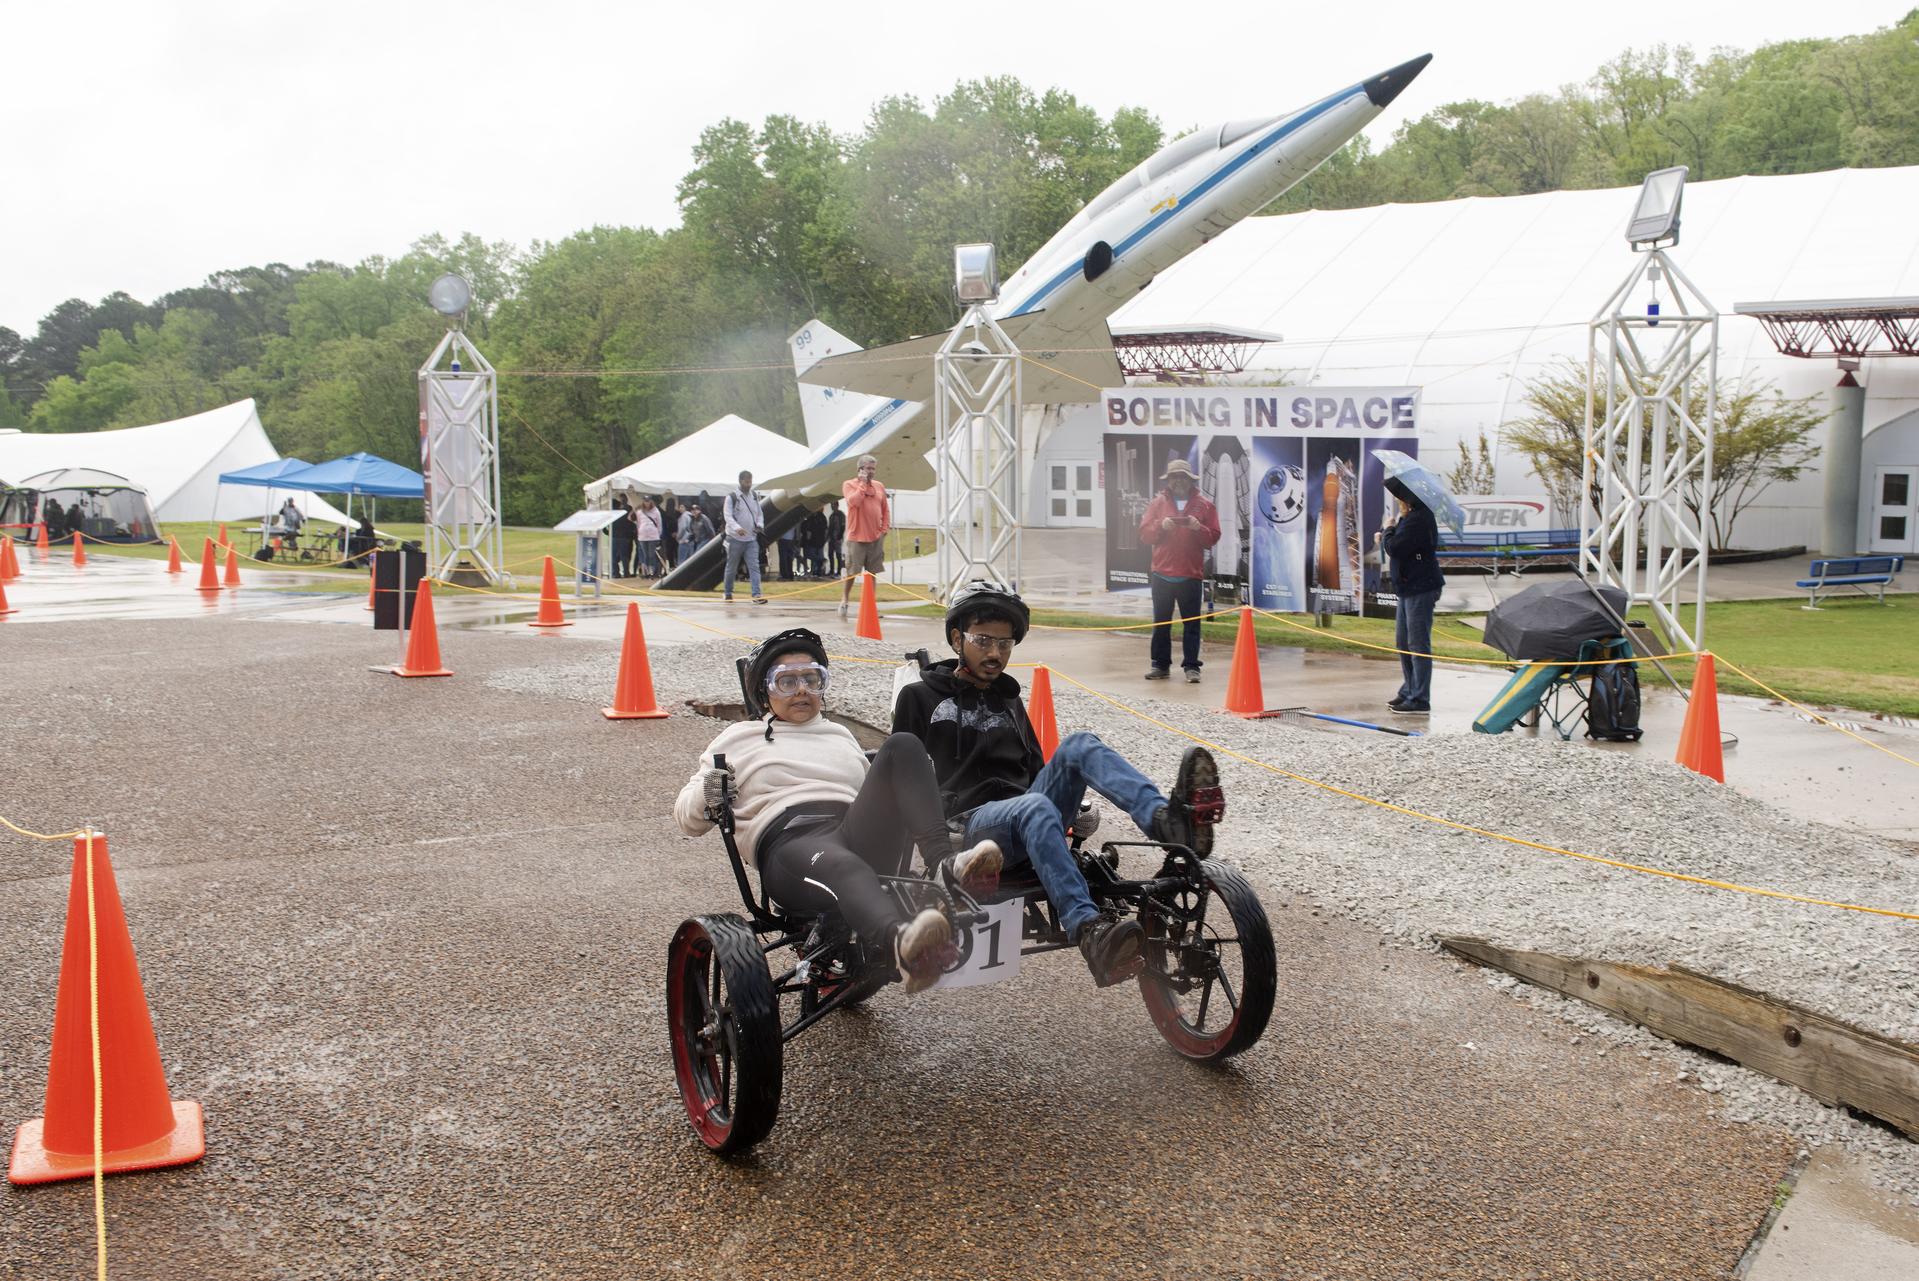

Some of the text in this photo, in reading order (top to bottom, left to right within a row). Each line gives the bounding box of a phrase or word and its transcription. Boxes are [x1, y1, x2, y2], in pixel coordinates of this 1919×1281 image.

[1107, 396, 1415, 429] BOEING IN SPACE
